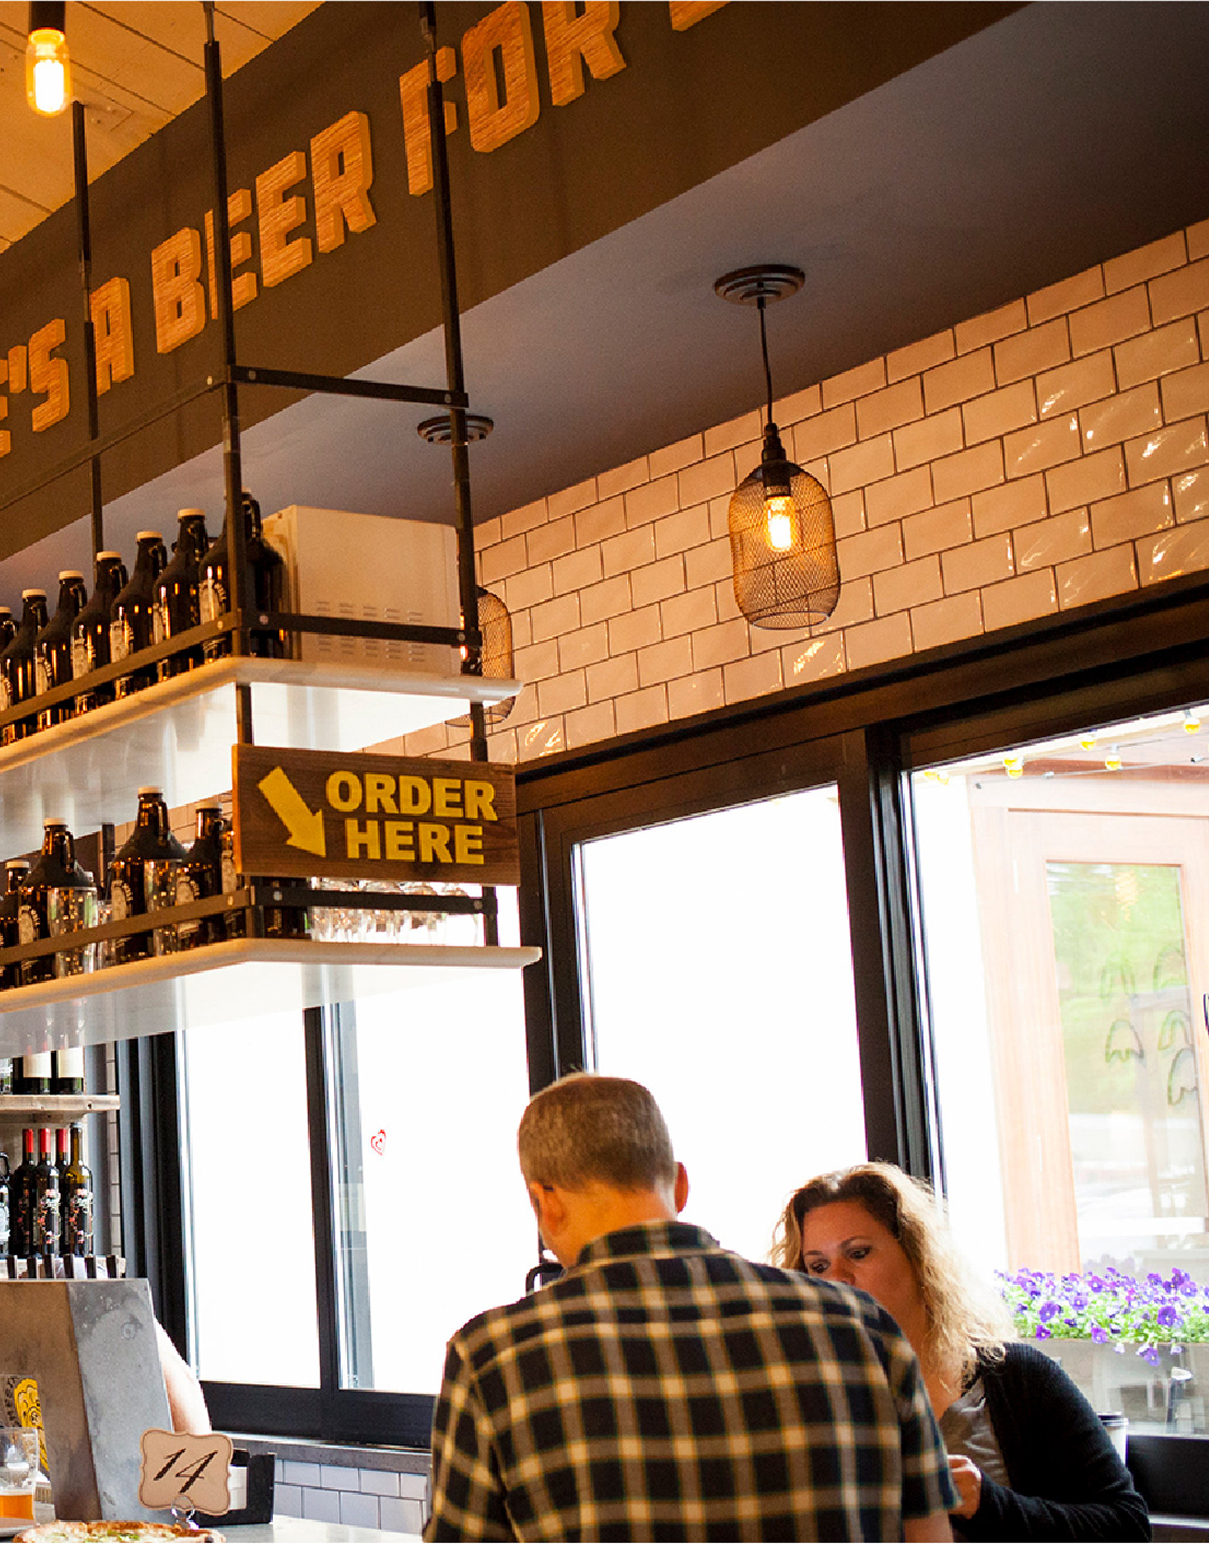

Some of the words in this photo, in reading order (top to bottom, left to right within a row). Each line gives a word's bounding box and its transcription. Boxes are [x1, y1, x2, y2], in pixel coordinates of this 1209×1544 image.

[91, 275, 136, 396] A
[151, 110, 378, 354] BEER
[399, 0, 627, 198] FOR
[325, 770, 498, 821] ORDER
[345, 818, 485, 865] HERE
[153, 1447, 219, 1494] 14
